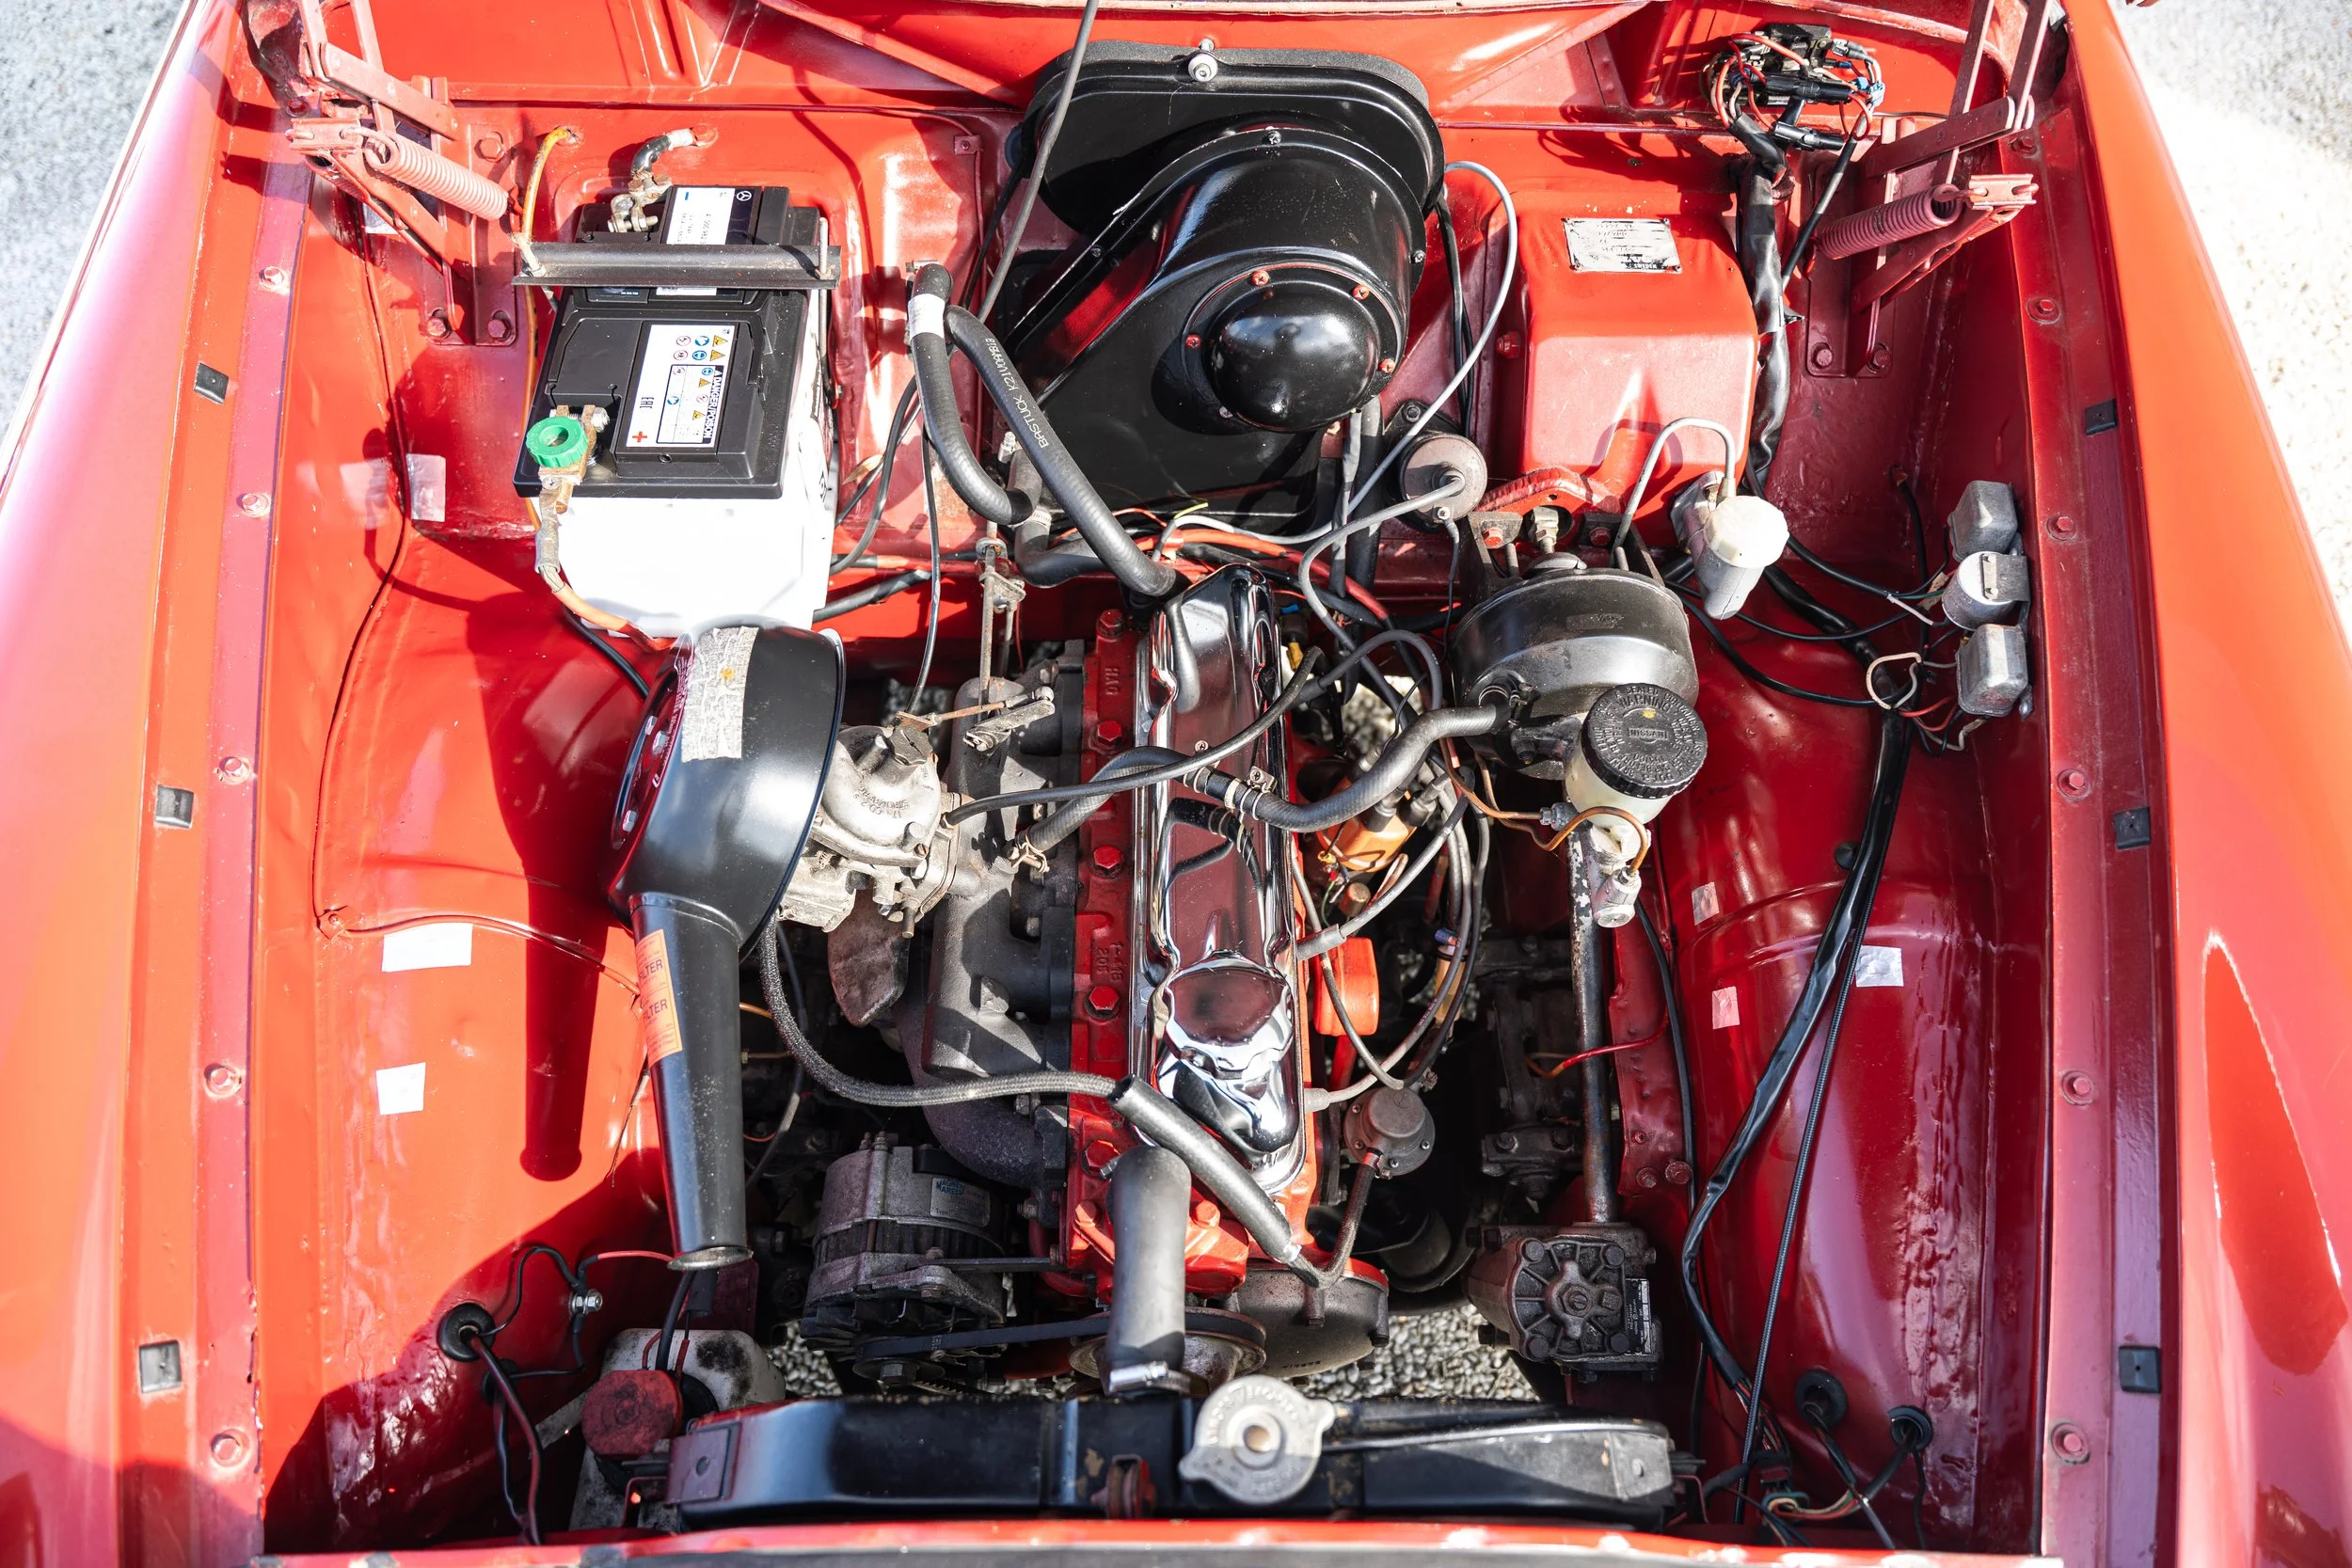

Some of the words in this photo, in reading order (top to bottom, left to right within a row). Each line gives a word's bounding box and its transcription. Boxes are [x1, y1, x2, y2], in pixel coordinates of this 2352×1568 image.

[1013, 395, 1049, 448] BASTUCK
[1626, 686, 1659, 696] SEALED
[1617, 694, 1672, 713] WARNING
[1631, 729, 1666, 739] NISSAN
